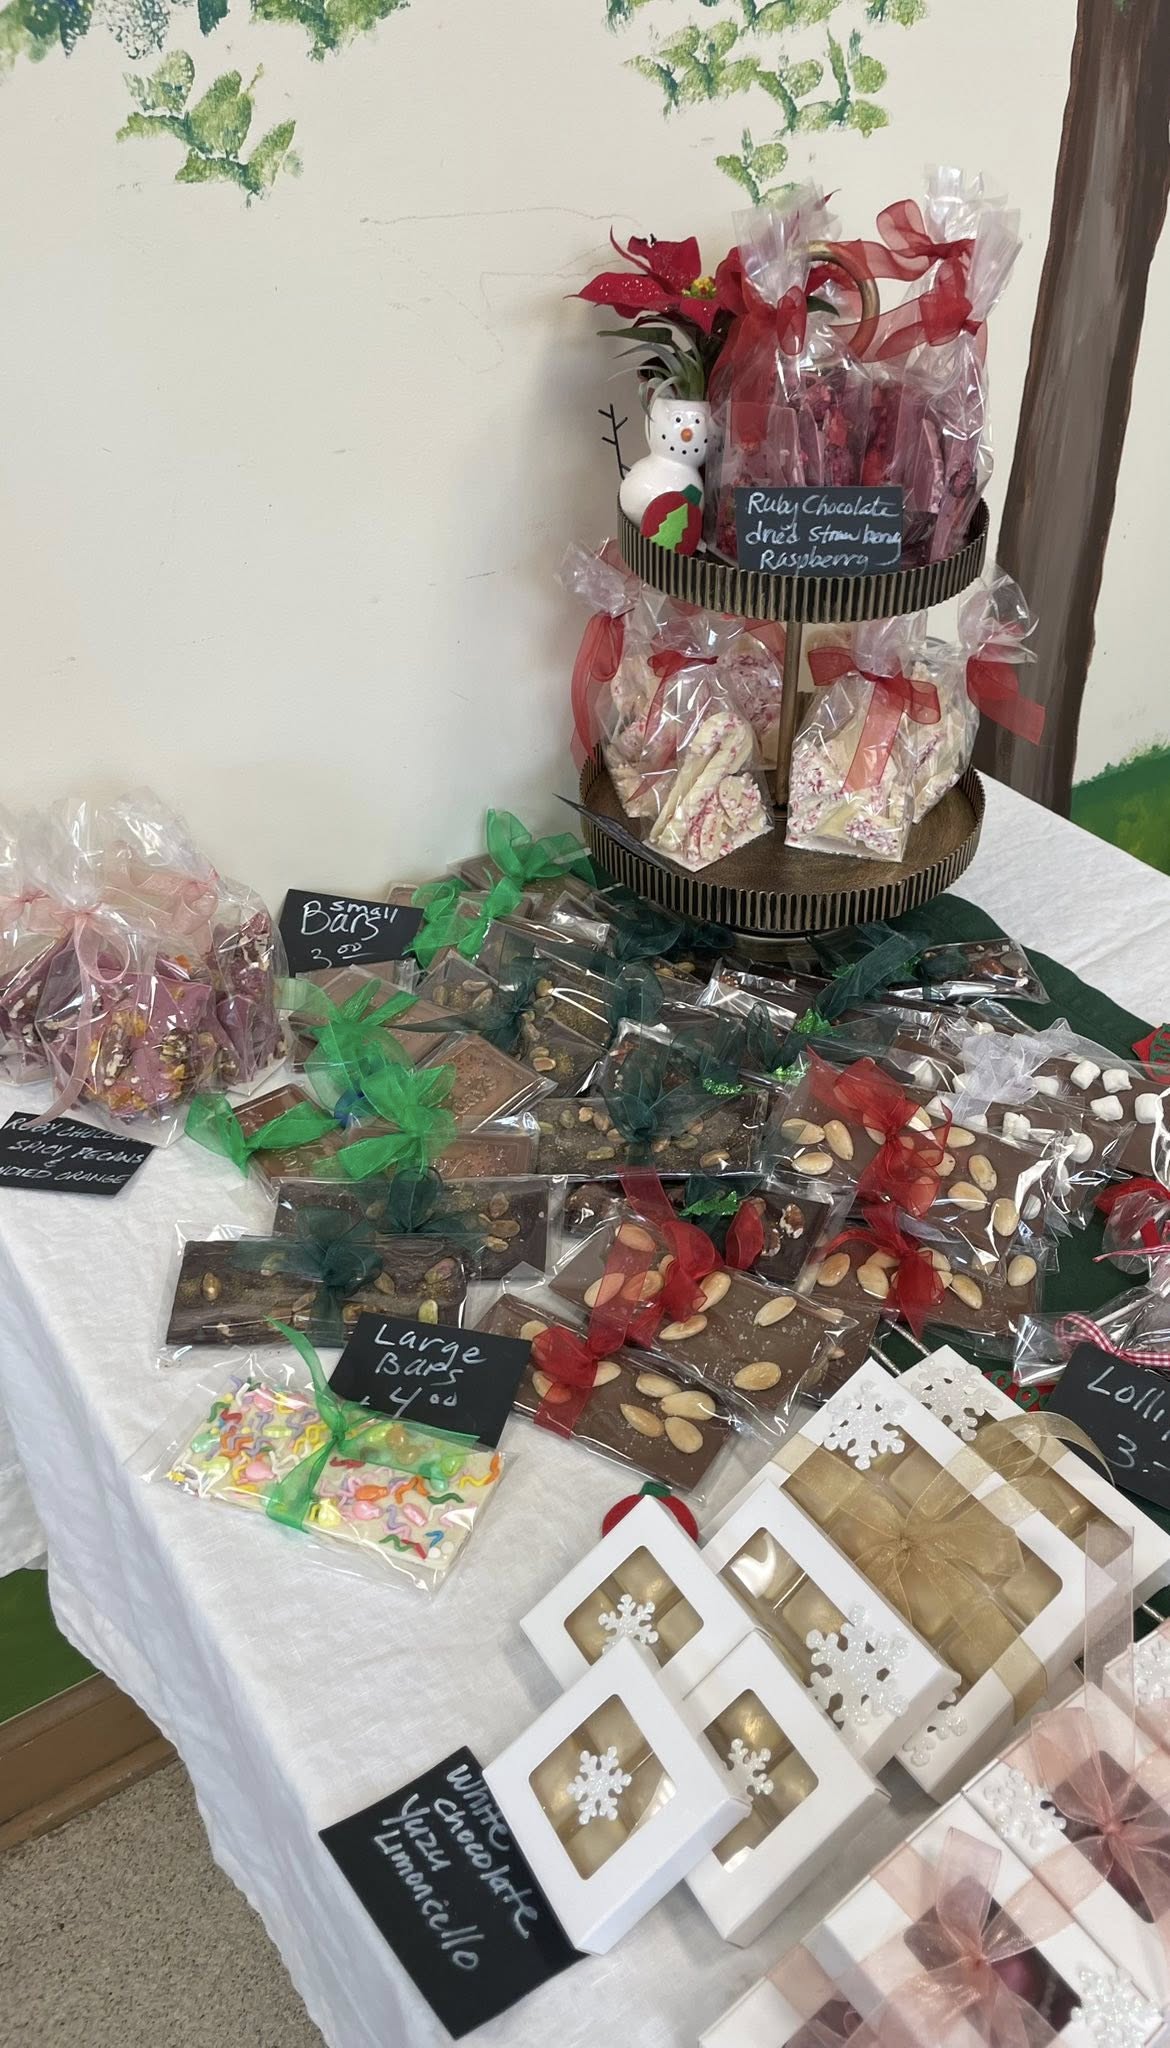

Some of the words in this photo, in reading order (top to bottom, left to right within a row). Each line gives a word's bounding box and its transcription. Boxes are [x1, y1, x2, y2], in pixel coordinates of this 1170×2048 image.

[748, 491, 799, 527] Ruby
[802, 494, 899, 517] Chocolate
[745, 520, 799, 544] dried
[760, 546, 869, 576] Raspberry
[301, 900, 379, 941] Bars
[7, 1140, 72, 1157] SPICY
[71, 1147, 144, 1164] PECANS
[54, 1171, 131, 1184] ORANGE
[374, 1323, 487, 1371] Large
[375, 1351, 464, 1386] Bars
[1087, 1365, 1170, 1441] Lolli
[446, 1764, 510, 1850] White
[381, 1793, 450, 1871] Yuzu
[373, 1830, 485, 1970] Limoncello
